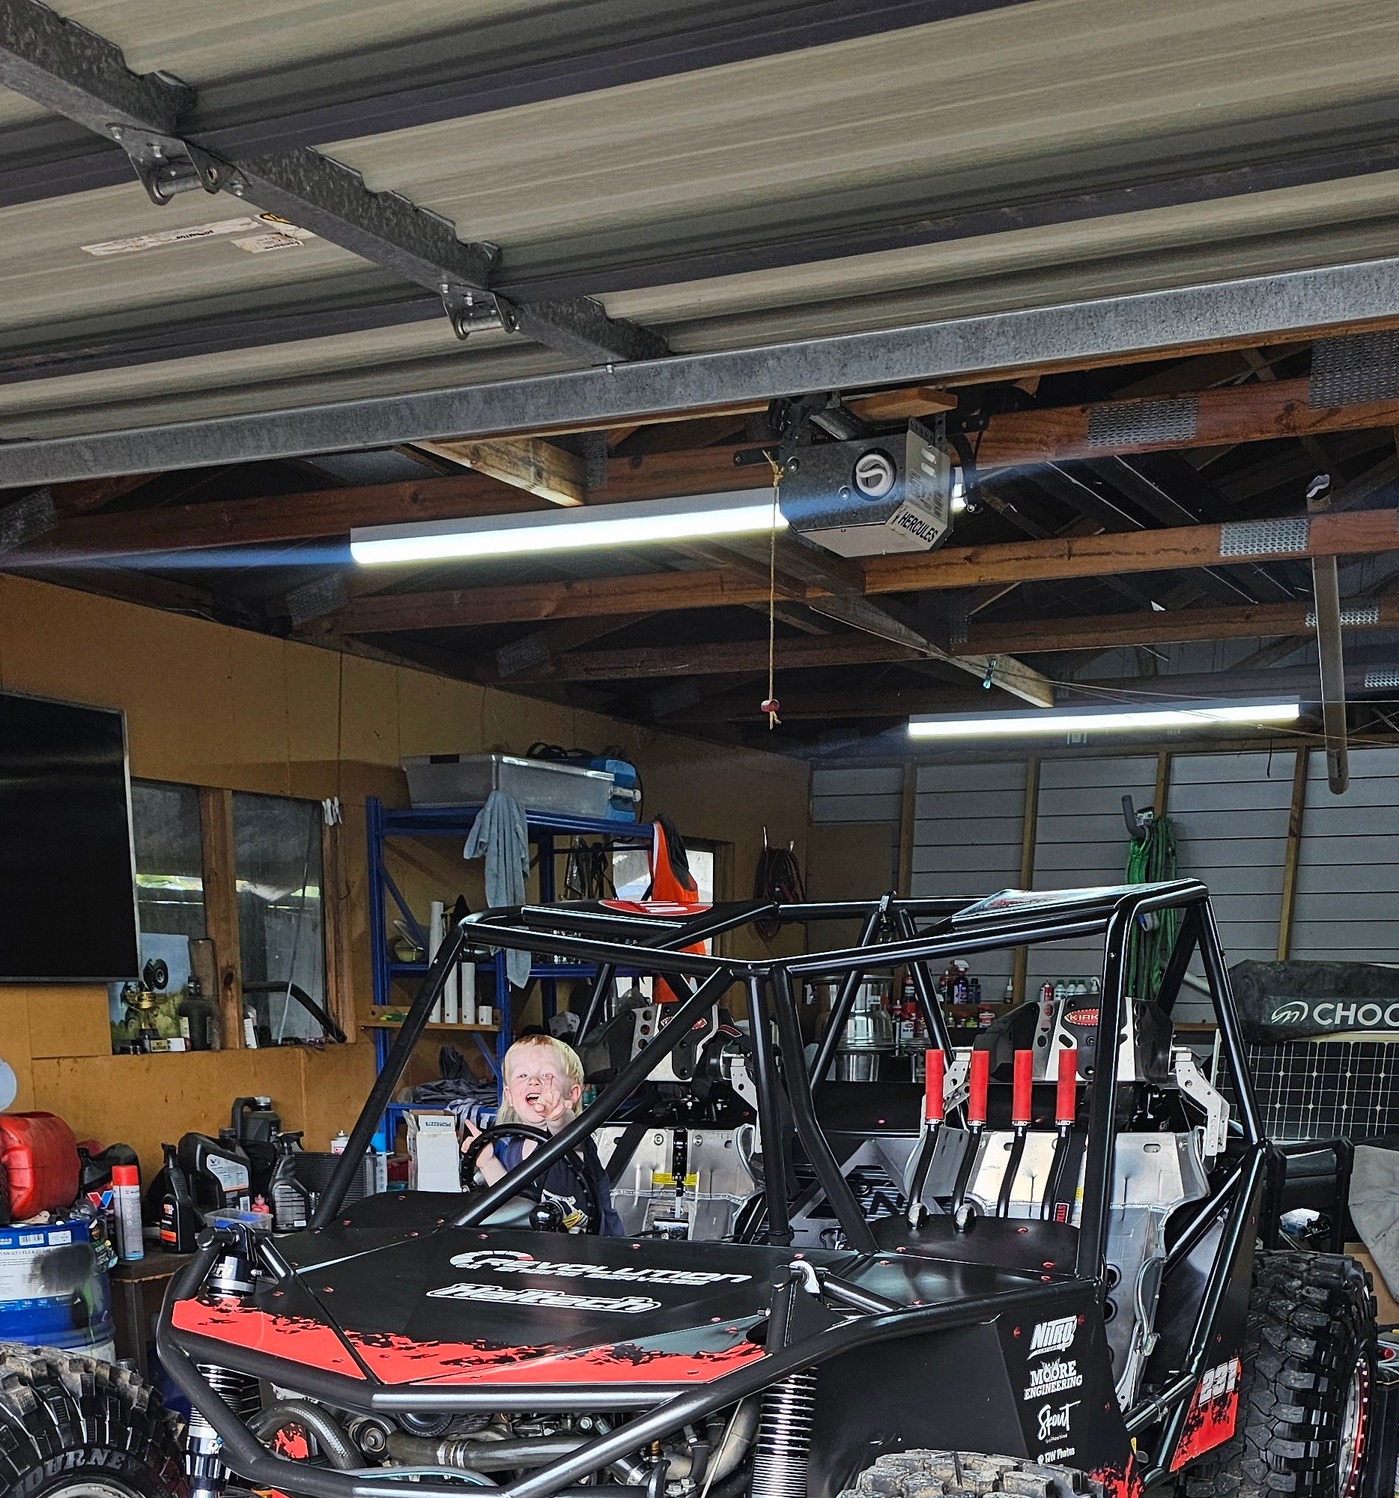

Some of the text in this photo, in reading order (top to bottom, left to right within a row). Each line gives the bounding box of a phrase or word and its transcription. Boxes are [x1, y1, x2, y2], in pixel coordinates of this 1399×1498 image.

[898, 511, 938, 542] HERCULES
[475, 1257, 752, 1284] REVOLUTION
[431, 1283, 658, 1312] Haltech
[1029, 1315, 1077, 1351] NITRO
[1023, 1375, 1083, 1400] ENGINEERING
[1030, 1360, 1077, 1387] MOORE
